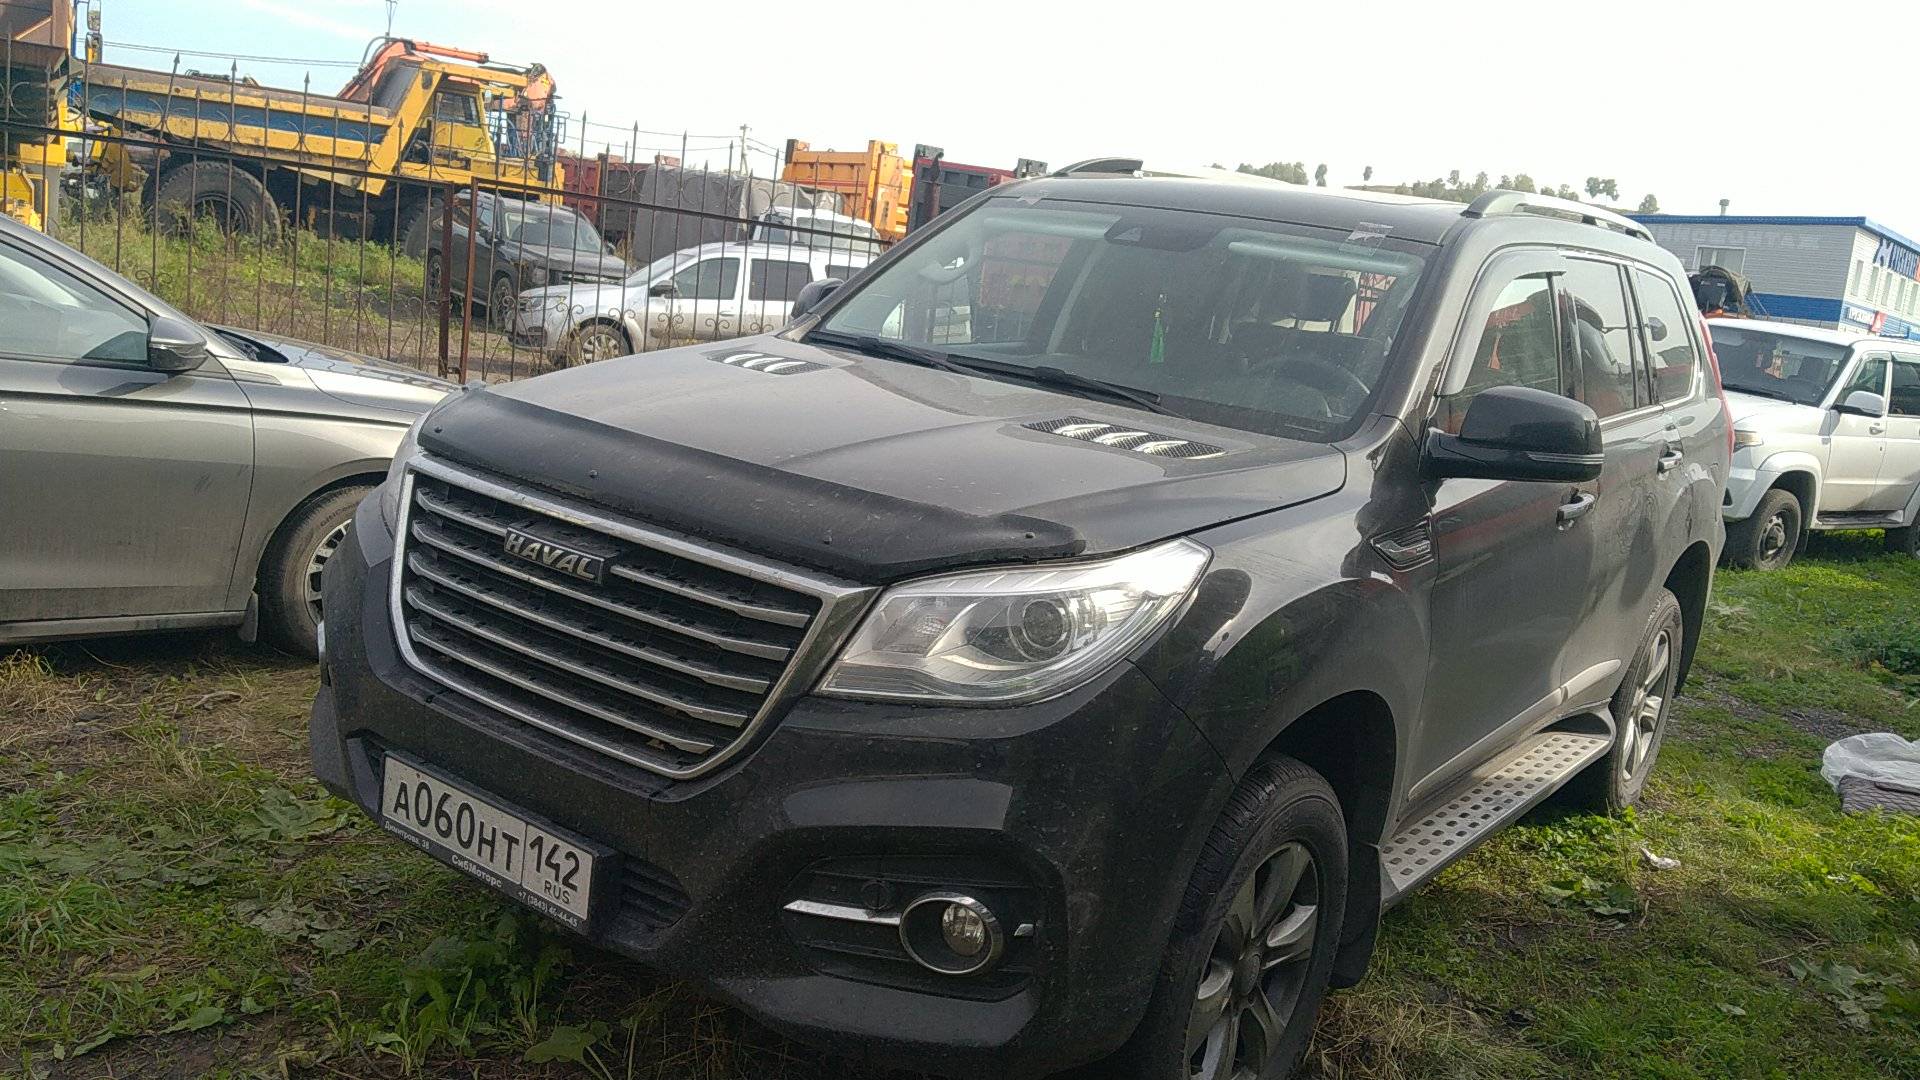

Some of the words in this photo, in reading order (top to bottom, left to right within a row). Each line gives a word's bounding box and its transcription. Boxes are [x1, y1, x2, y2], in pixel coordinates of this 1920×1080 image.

[505, 533, 595, 580] HAVAL
[451, 854, 502, 888] СибМоторс
[529, 834, 580, 892] 142
[544, 880, 570, 905] RUS
